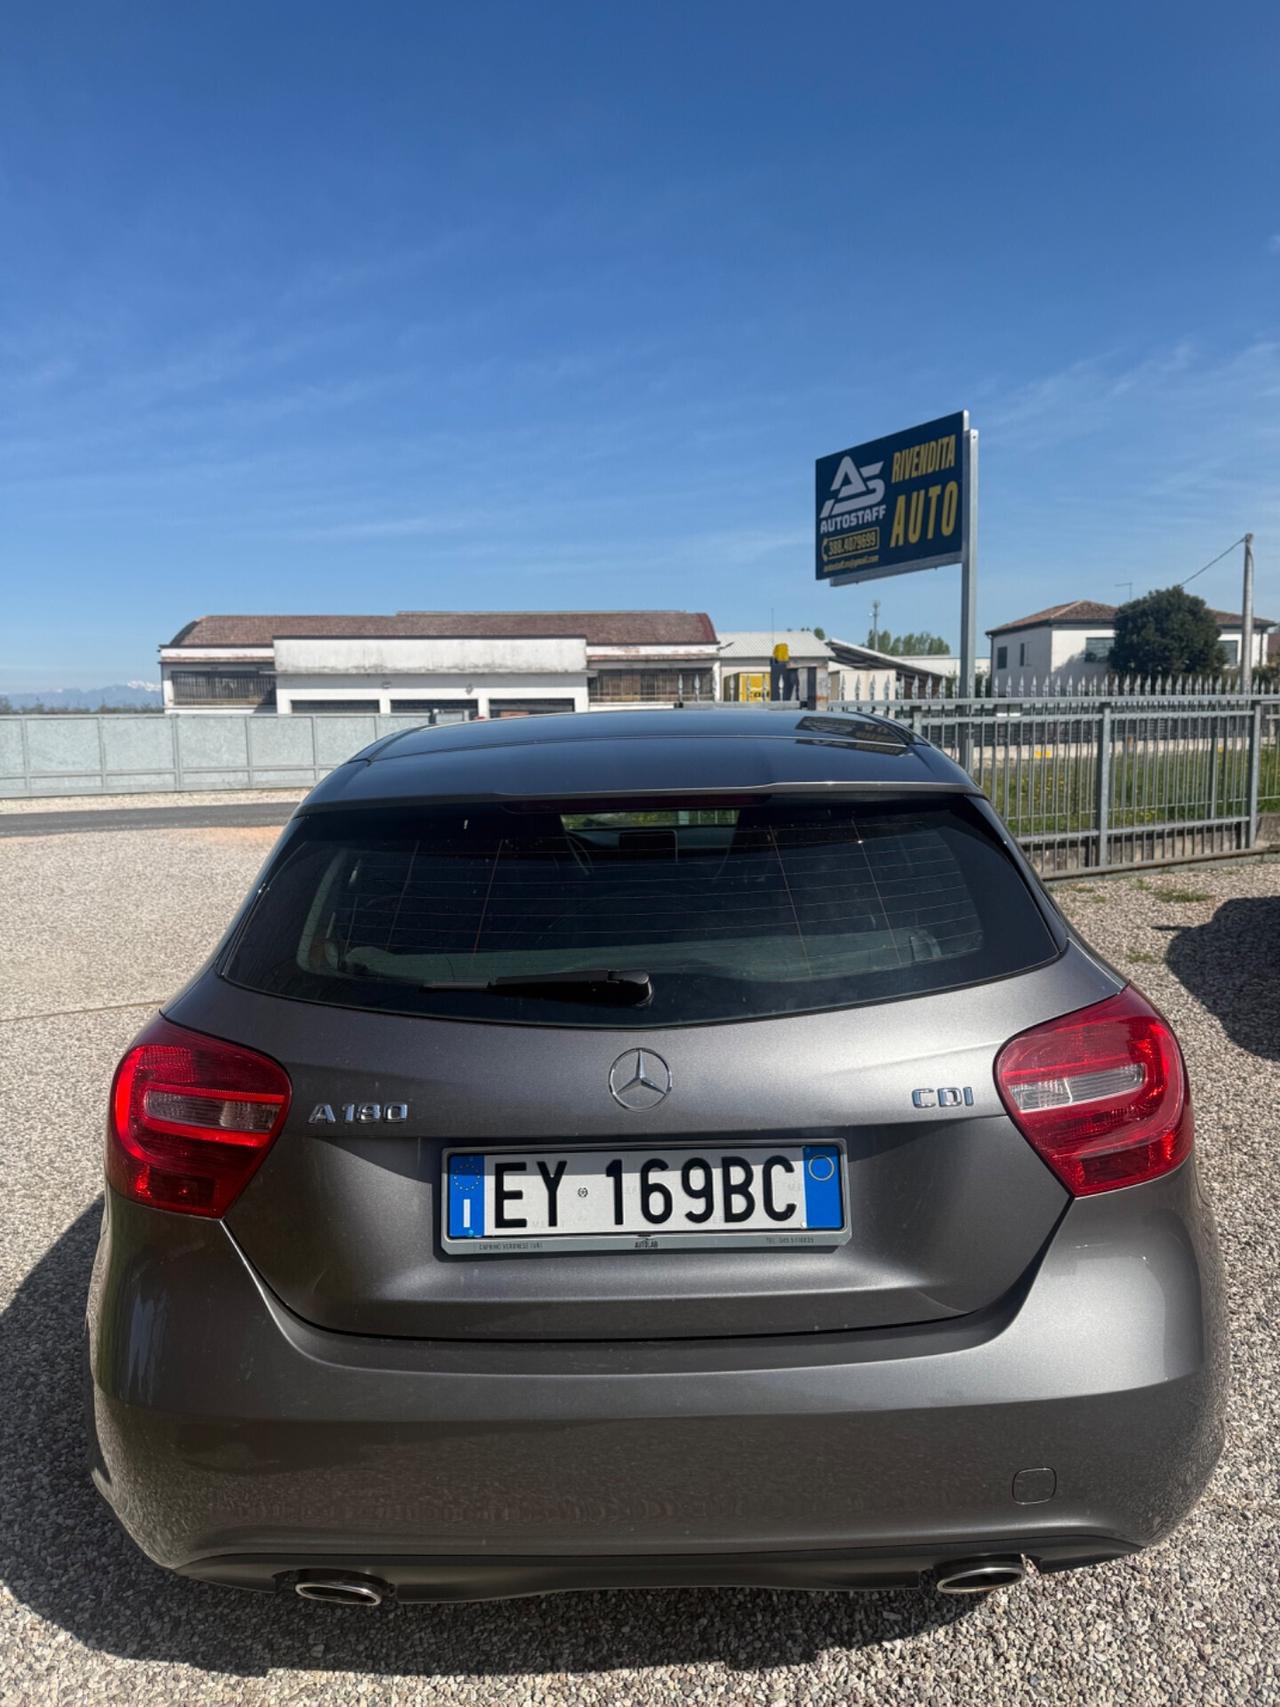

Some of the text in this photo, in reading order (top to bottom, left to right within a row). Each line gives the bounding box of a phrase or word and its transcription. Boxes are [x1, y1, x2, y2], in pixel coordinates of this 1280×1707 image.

[891, 434, 956, 484] RIVENDITA
[820, 504, 887, 534] AUTOSTAFF
[889, 480, 959, 549] AUTO
[911, 1086, 975, 1109] CDI
